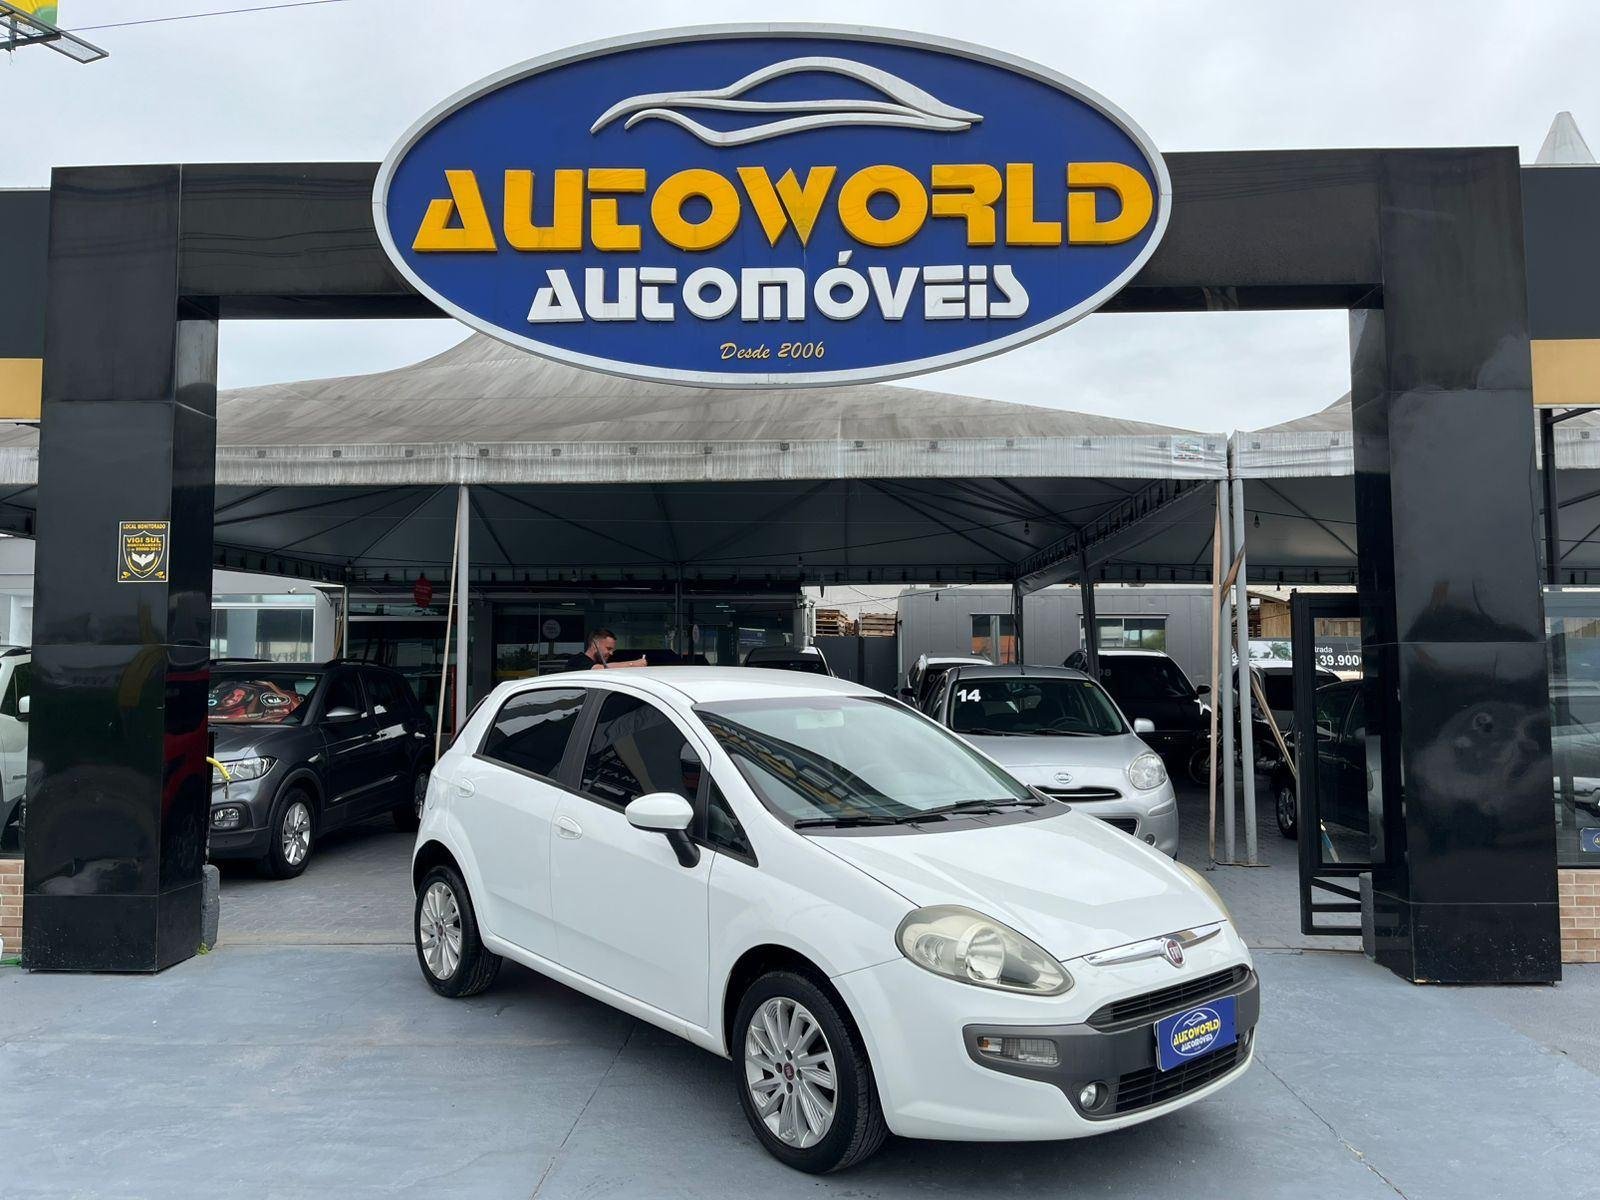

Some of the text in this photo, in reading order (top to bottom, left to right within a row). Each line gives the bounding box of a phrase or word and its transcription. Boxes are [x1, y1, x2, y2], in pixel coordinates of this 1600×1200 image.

[411, 163, 1153, 252] AUTOWORLD
[527, 251, 1030, 322] AUTOMÓVEIS
[720, 341, 825, 359] Desde 2006
[1320, 655, 1362, 666] 39.900
[957, 689, 981, 703] 14
[1173, 1019, 1219, 1046] AUTOWORLD
